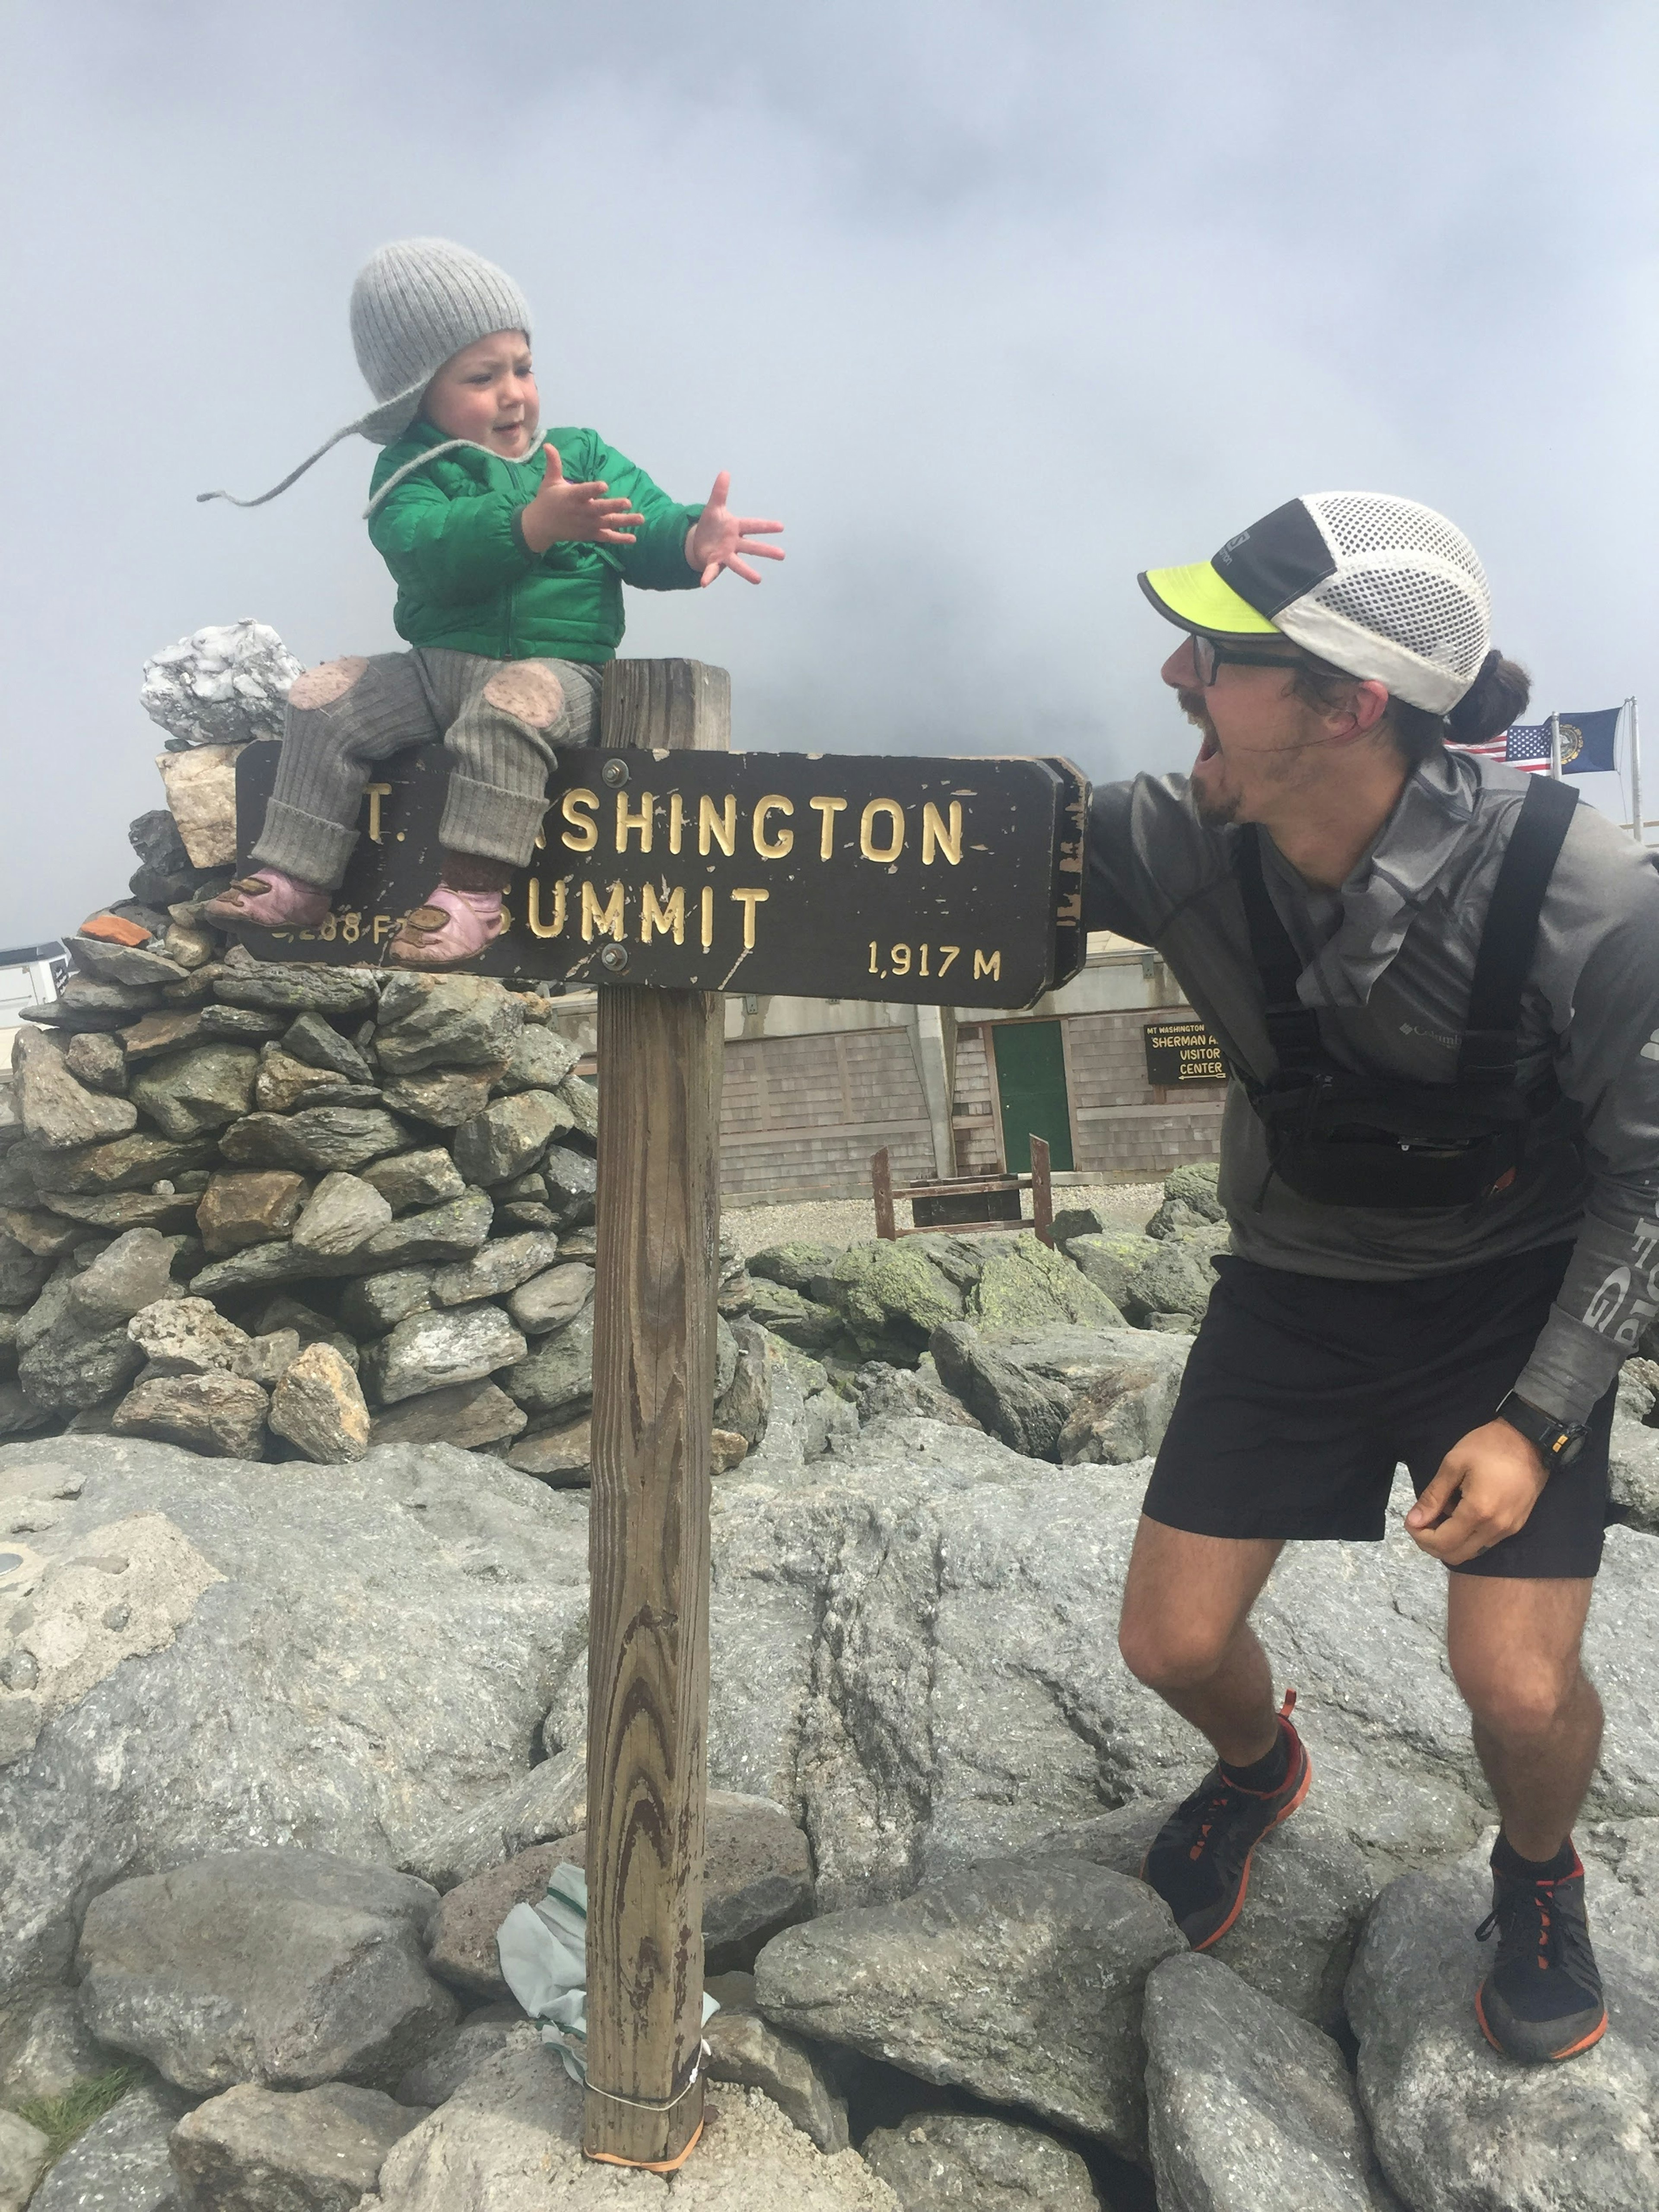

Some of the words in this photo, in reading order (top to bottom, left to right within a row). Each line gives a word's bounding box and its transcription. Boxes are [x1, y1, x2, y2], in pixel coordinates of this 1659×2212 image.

[366, 783, 405, 842] T.
[535, 788, 962, 865] SHINGTON
[868, 941, 960, 979] 1,917
[973, 949, 1001, 981] M
[1159, 1025, 1205, 1033] WASHINGTON
[1414, 1026, 1462, 1046] Columb
[1152, 1035, 1206, 1049] SHERMAN
[1180, 1049, 1220, 1060] VISITOR
[1180, 1062, 1222, 1074] CENTER
